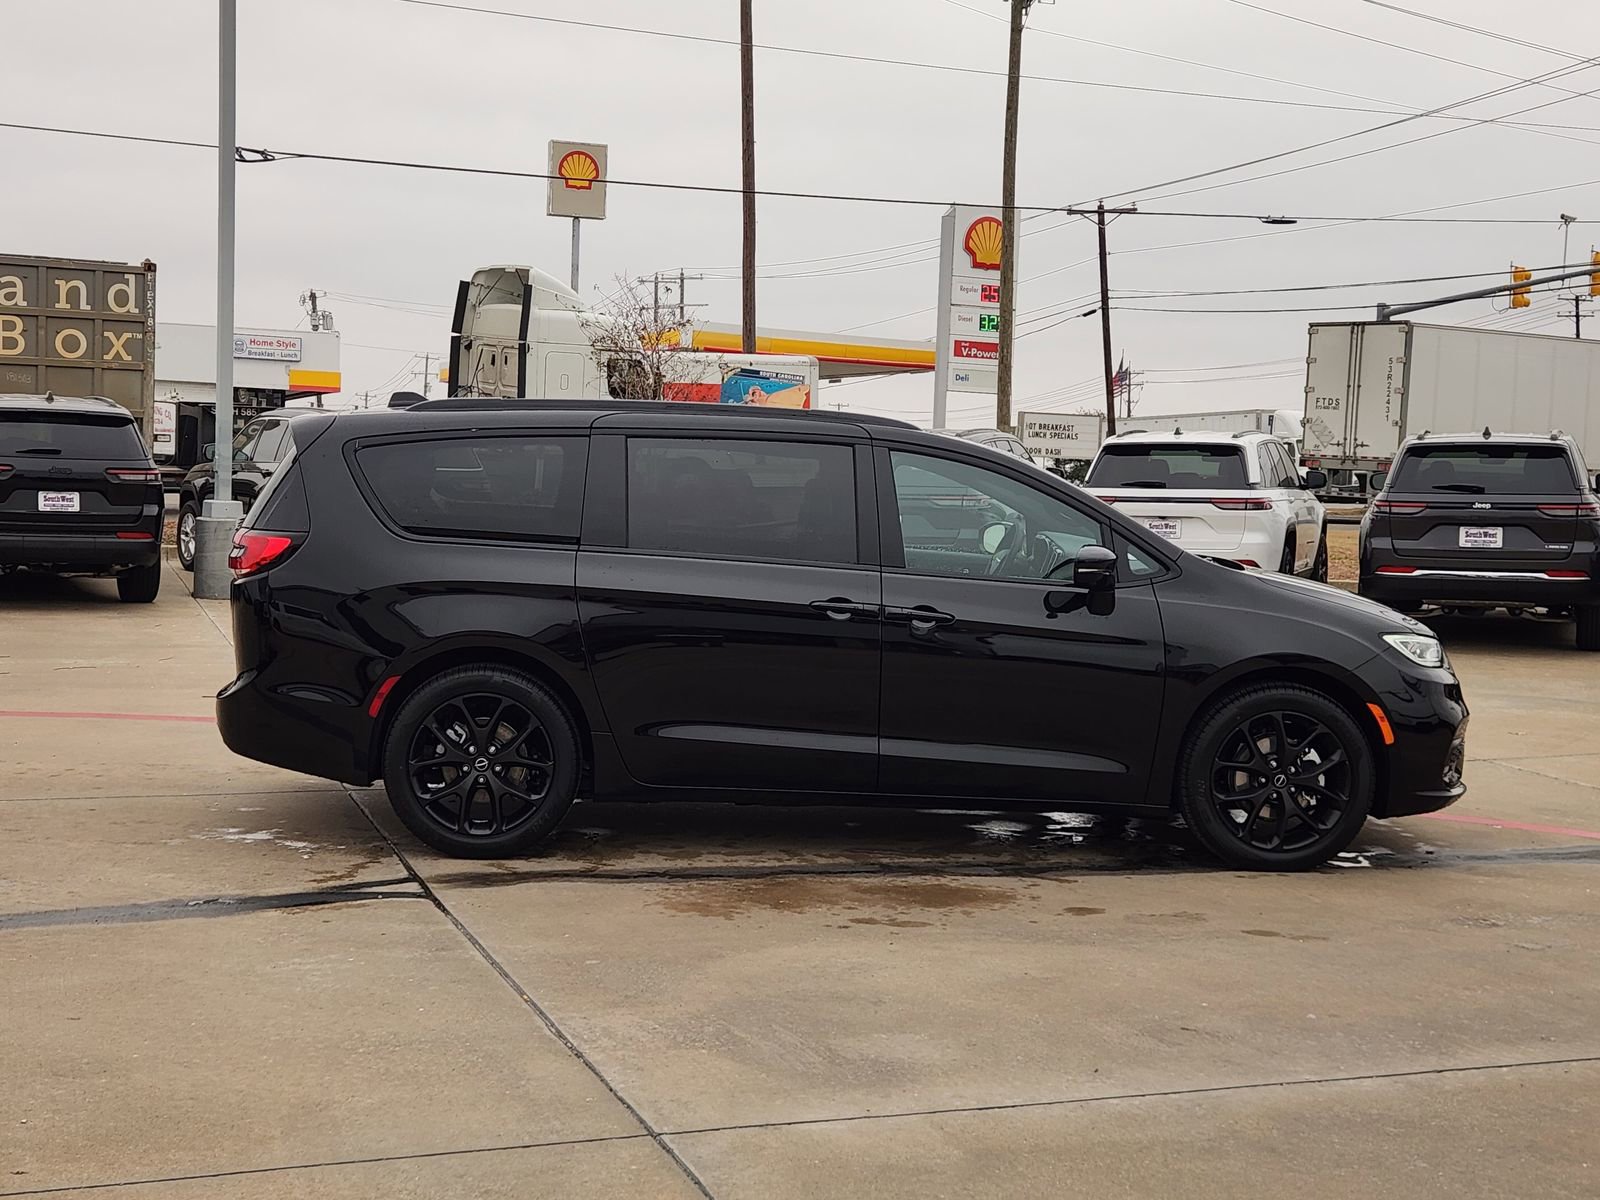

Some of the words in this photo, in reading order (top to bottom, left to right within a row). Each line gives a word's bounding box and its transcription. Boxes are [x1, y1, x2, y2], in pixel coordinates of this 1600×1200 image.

[960, 285, 979, 294] Regular
[958, 315, 973, 323] Diesel
[980, 315, 1000, 332] 32
[249, 338, 274, 347] Home
[276, 340, 297, 350] Style
[248, 350, 275, 358] Breakfast
[955, 374, 970, 382] Deli
[1315, 397, 1340, 406] FTDS
[241, 408, 257, 416] 585
[1038, 423, 1074, 432] BREAKFAST
[1049, 432, 1079, 440] SPECIALS
[1045, 448, 1061, 456] DASH
